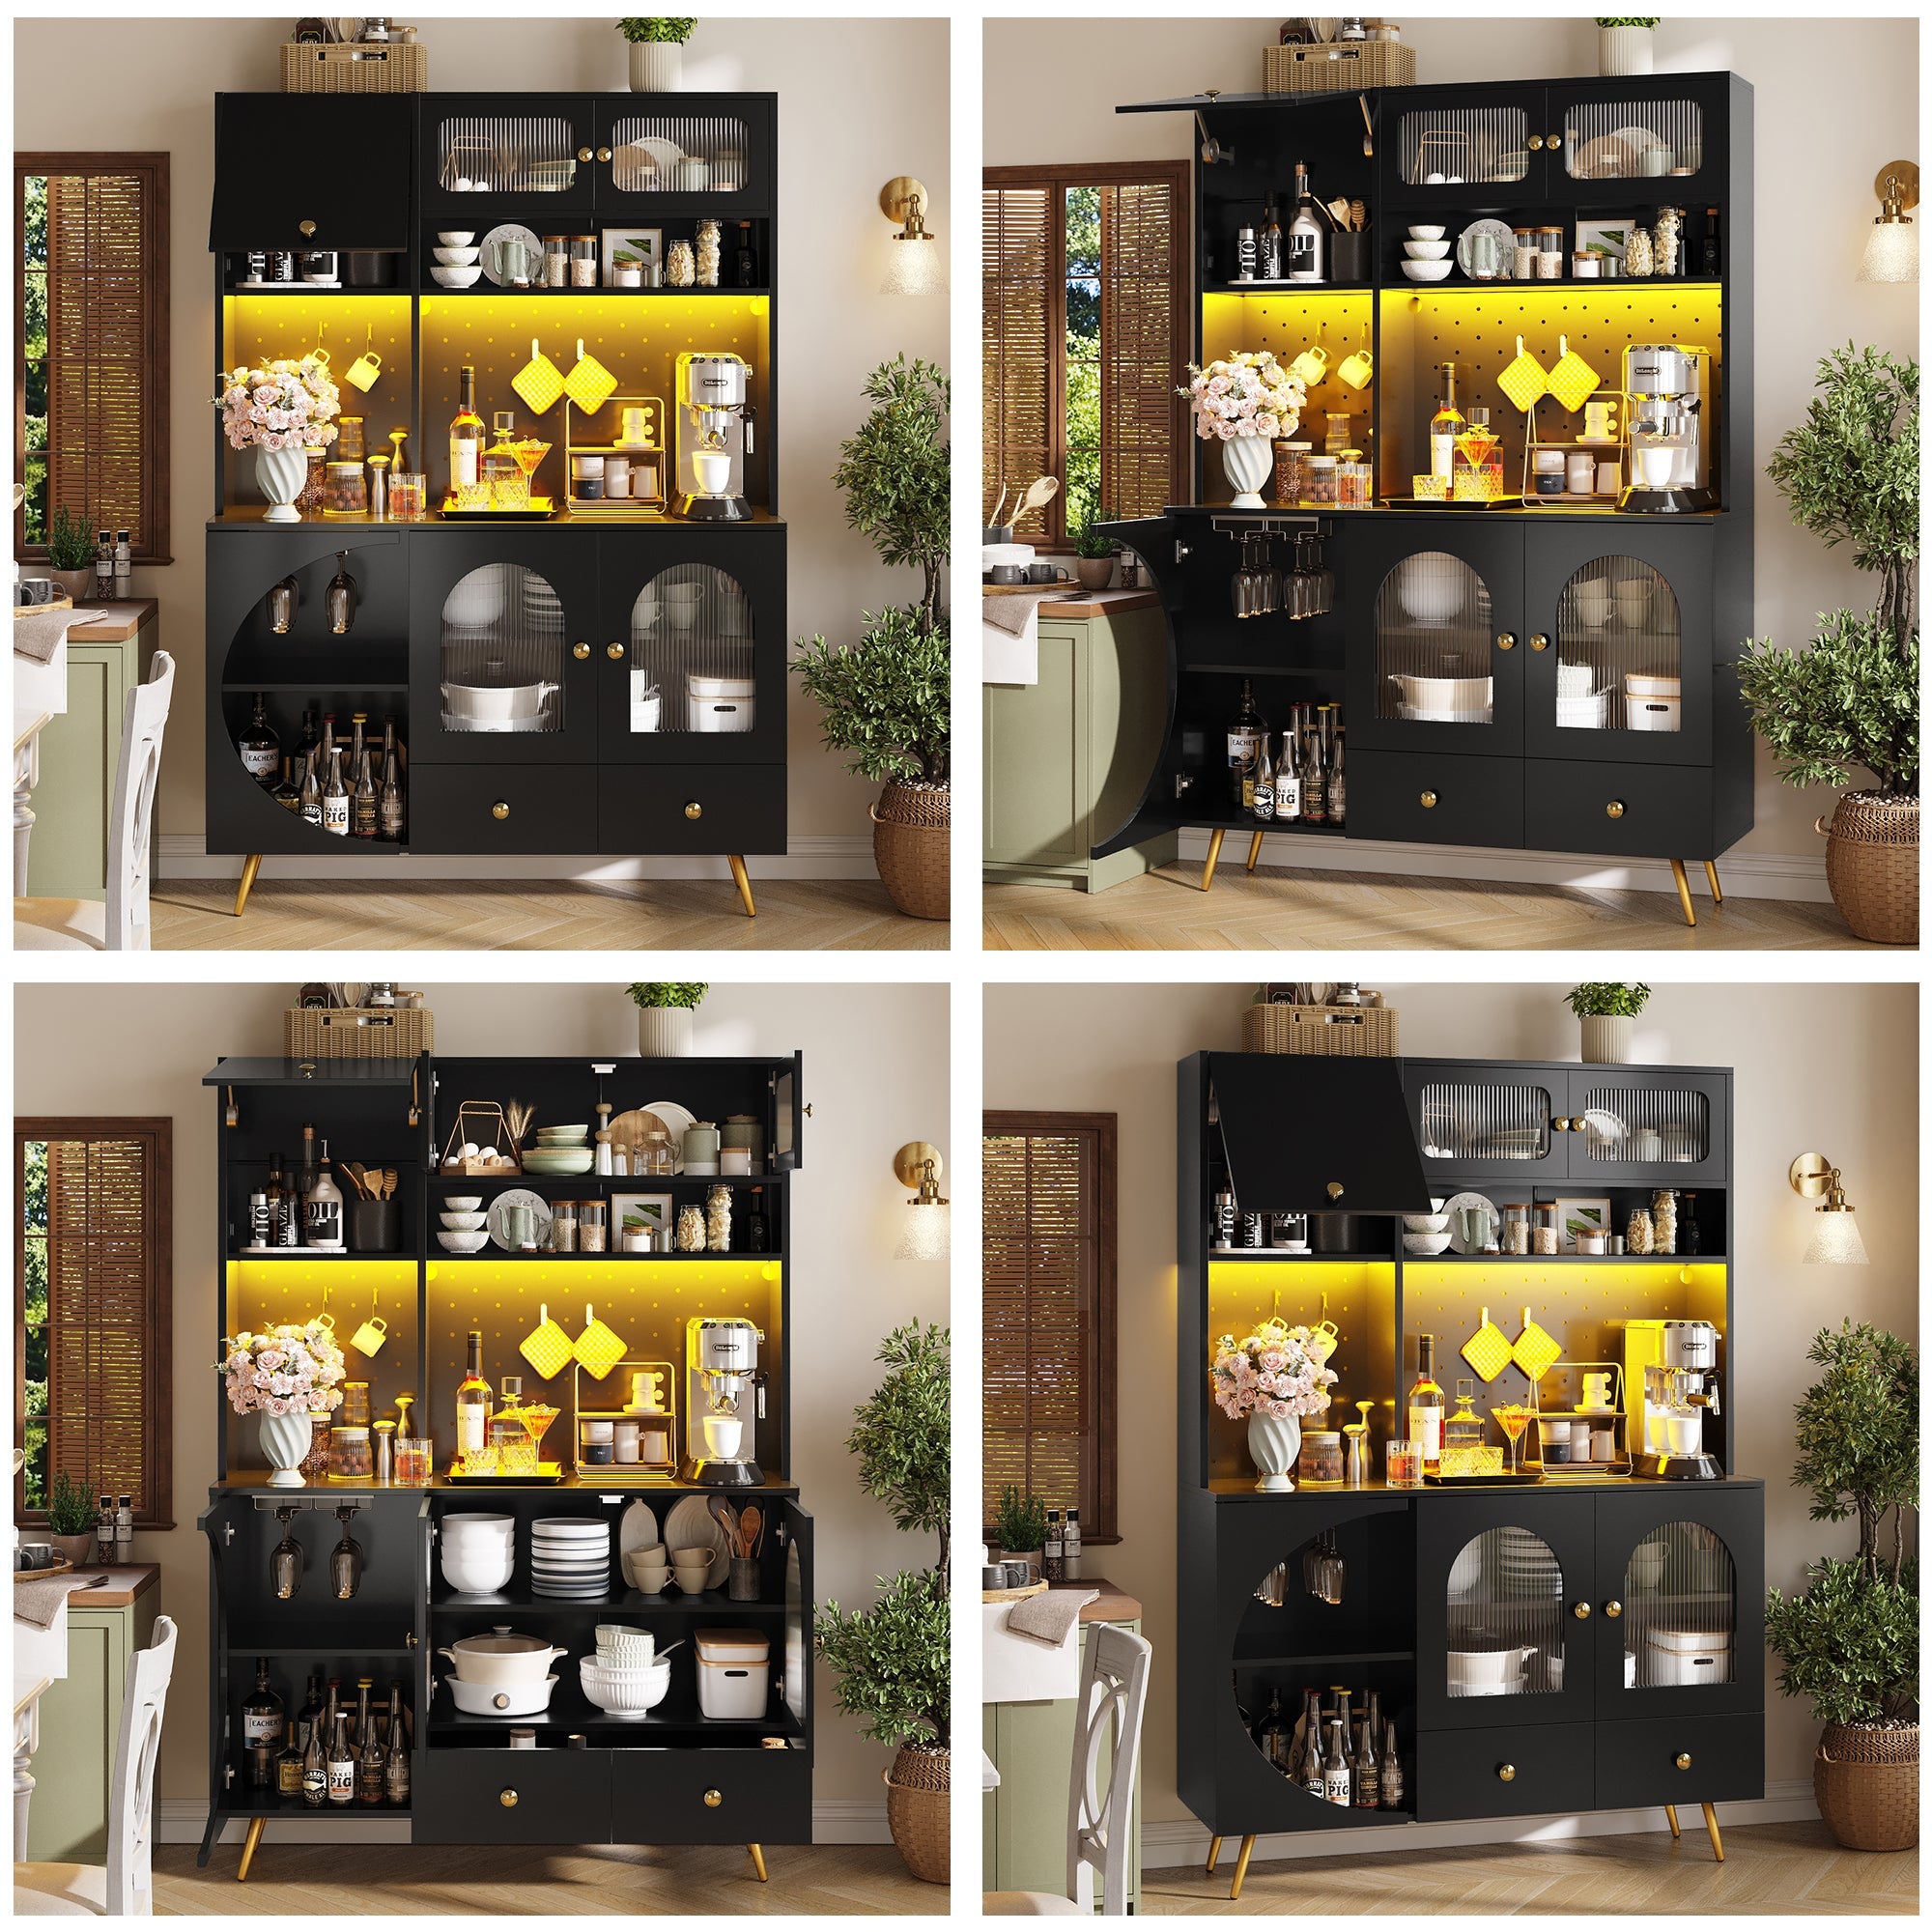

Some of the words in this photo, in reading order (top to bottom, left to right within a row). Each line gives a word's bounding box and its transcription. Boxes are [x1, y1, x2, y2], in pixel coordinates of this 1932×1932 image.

[250, 251, 266, 274] IL
[1241, 240, 1256, 273] OIL
[1276, 794, 1296, 804] PIG
[326, 811, 347, 822] PIG
[307, 1203, 338, 1218] OIL
[255, 1206, 270, 1240] OIL
[1222, 1206, 1235, 1240] OIL
[329, 1776, 353, 1788] PIG
[1327, 1784, 1350, 1796] PIG
